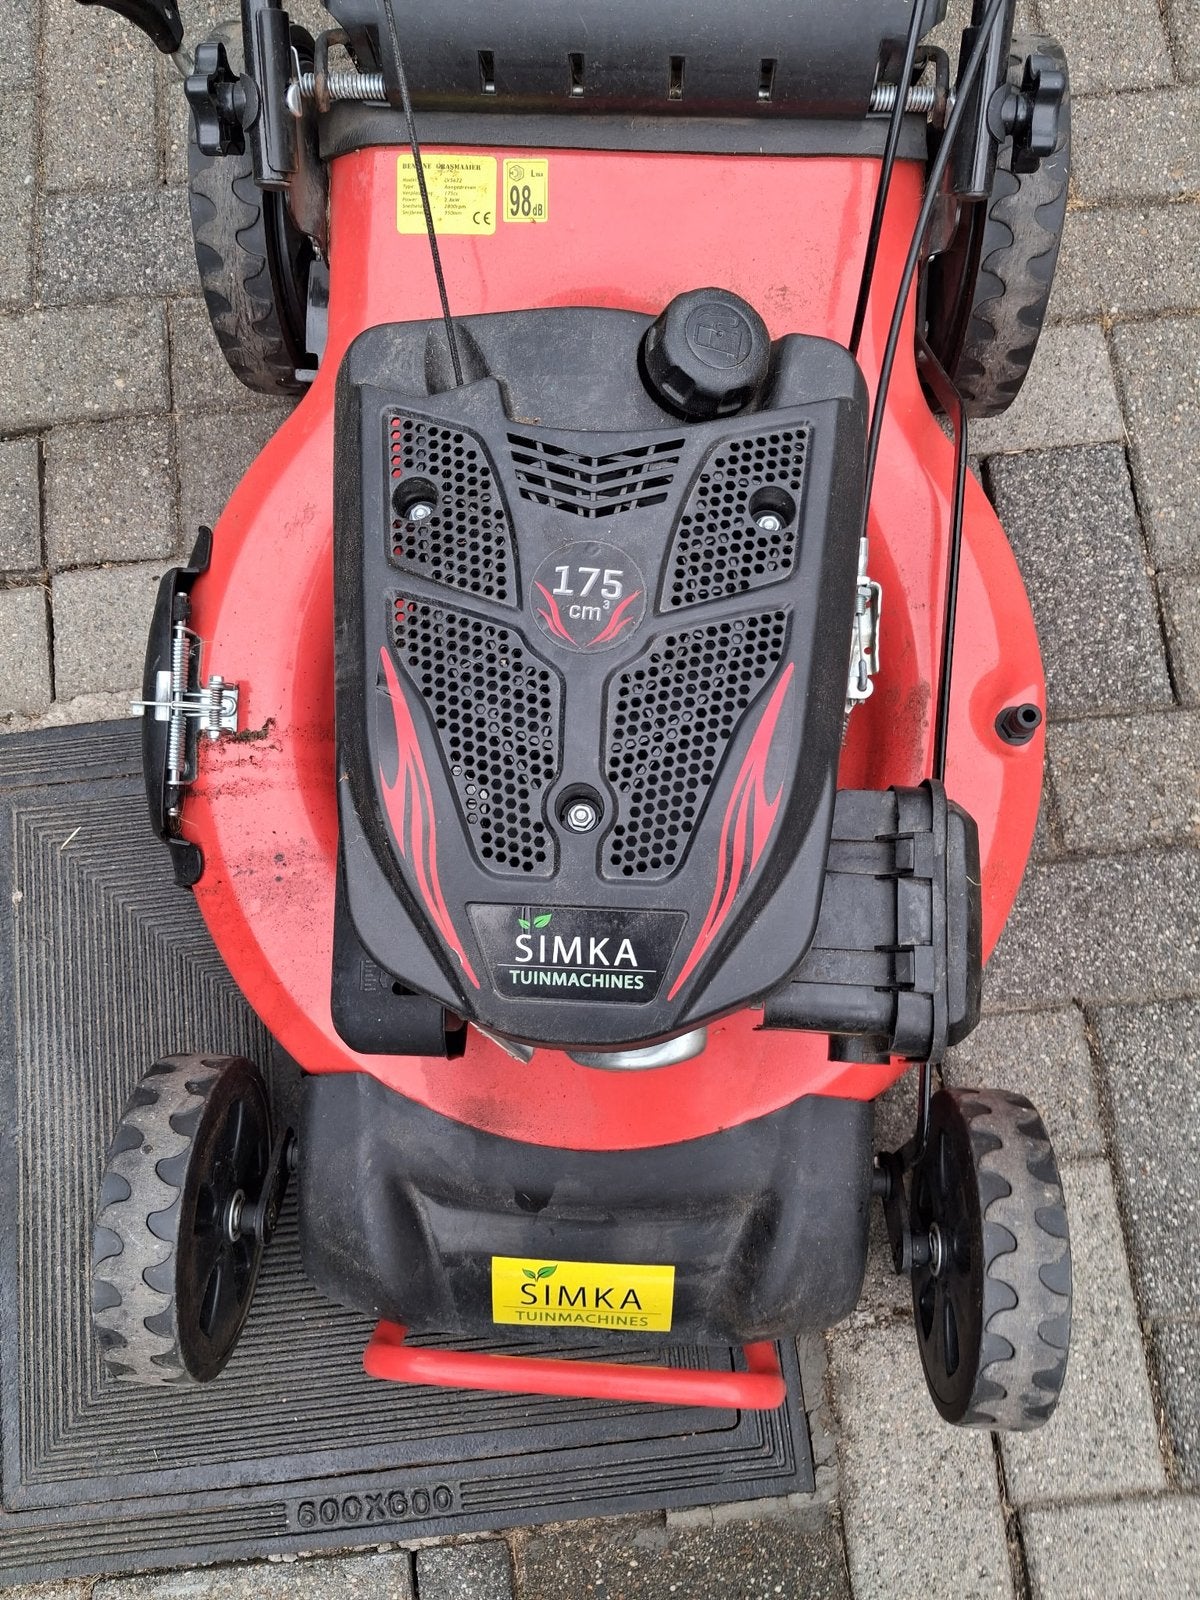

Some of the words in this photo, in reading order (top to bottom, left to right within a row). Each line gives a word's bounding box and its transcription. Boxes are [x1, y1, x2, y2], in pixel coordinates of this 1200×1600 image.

[510, 185, 531, 216] 98
[533, 203, 543, 216] dB
[553, 565, 624, 600] 175
[515, 934, 638, 967] SIMKA
[509, 970, 644, 989] TUINMACHINES
[520, 1283, 642, 1310] SIMKA
[515, 1311, 649, 1327] TUINMACHINES
